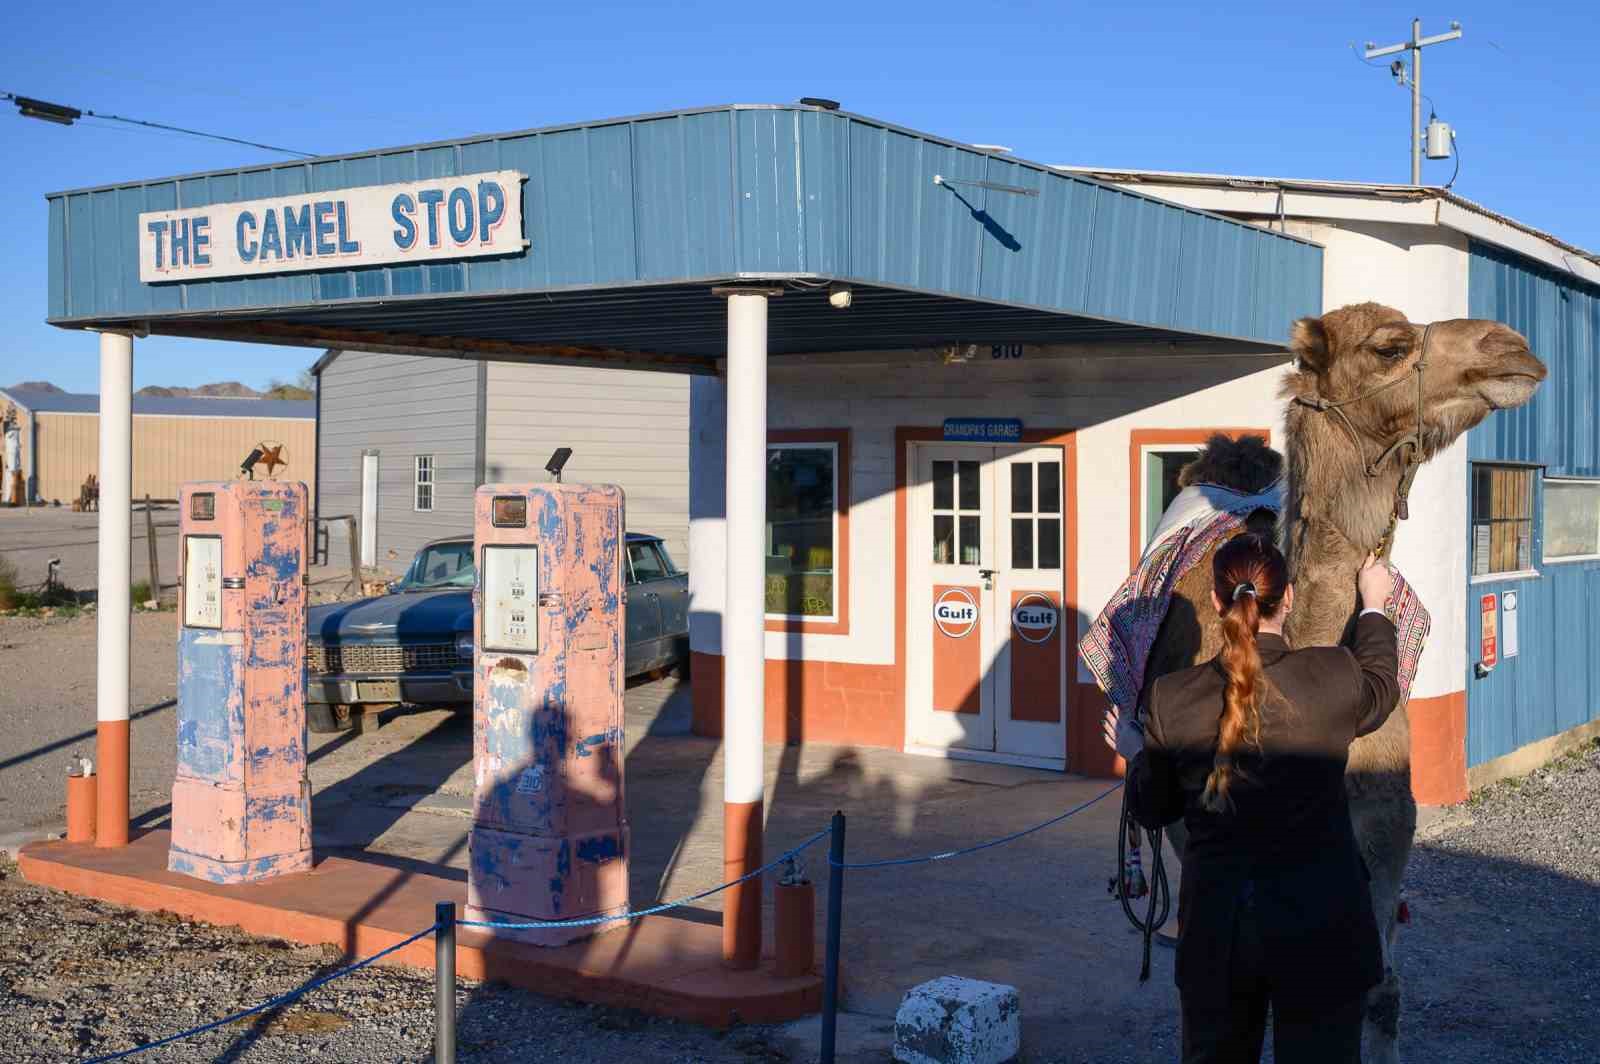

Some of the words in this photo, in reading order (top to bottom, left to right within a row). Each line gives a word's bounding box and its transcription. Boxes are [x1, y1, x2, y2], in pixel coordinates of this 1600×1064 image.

[147, 215, 212, 270] THE
[235, 200, 361, 264] CAMEL
[391, 179, 506, 252] STOP
[987, 423, 1020, 437] GARAGE
[938, 606, 973, 619] Gulf
[1017, 611, 1053, 624] Gulf
